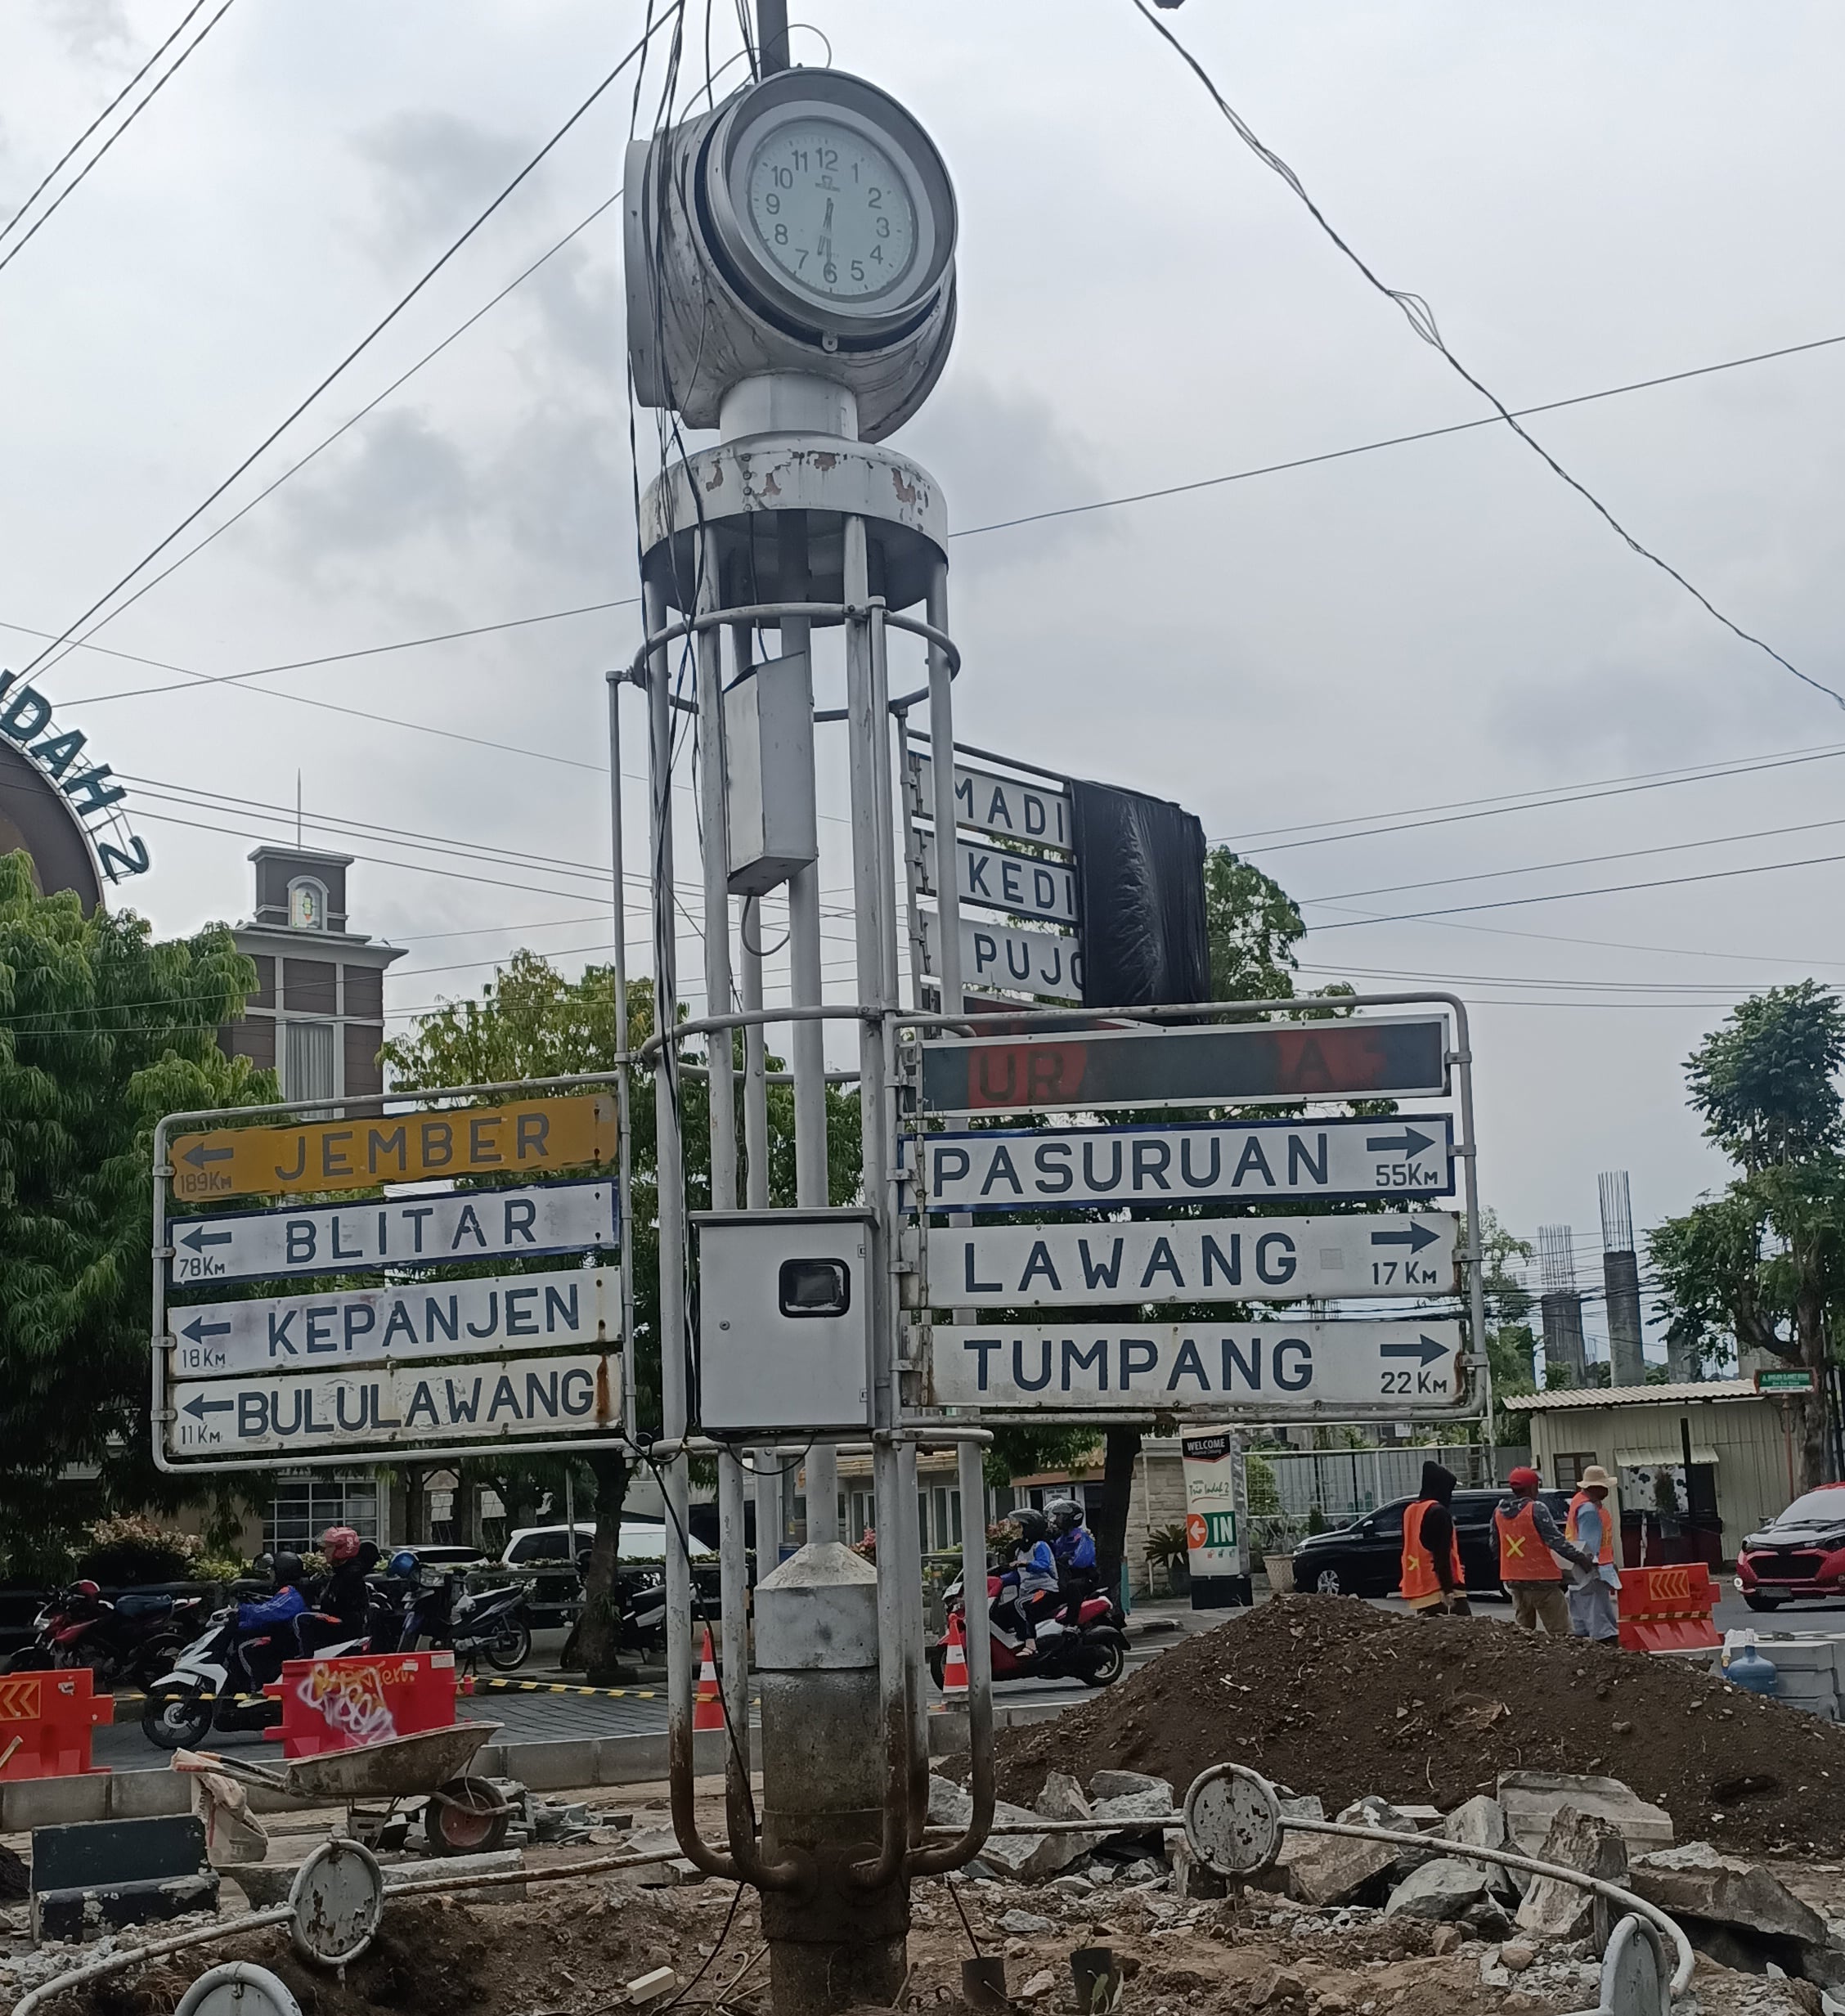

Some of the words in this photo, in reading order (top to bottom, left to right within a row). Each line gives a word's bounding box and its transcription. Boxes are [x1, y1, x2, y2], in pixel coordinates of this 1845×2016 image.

[791, 149, 809, 173] 11
[815, 147, 838, 172] 12
[771, 165, 793, 189] 10
[851, 163, 859, 183] 1
[765, 193, 780, 215] 9
[868, 187, 882, 209] 2
[774, 223, 788, 245] 8
[876, 217, 890, 238] 3
[795, 248, 810, 269] 7
[869, 245, 883, 265] 4
[823, 263, 837, 284] 6
[851, 260, 864, 281] 5
[0, 668, 127, 818] DAH
[955, 778, 1064, 843] MADI
[968, 852, 1074, 915] KEDI
[973, 933, 1084, 990] PUJ
[275, 1112, 550, 1181] JEMBER
[933, 1133, 1328, 1197] PASURUAN
[285, 1199, 537, 1264] BLITAR
[964, 1232, 1297, 1292] LAWANG
[268, 1283, 580, 1358] KEPANJEN
[963, 1338, 1313, 1392] TUMPANG
[237, 1369, 595, 1438] BULULAWANG
[1187, 1439, 1225, 1451] WELCOME
[1213, 1515, 1233, 1543] IN
